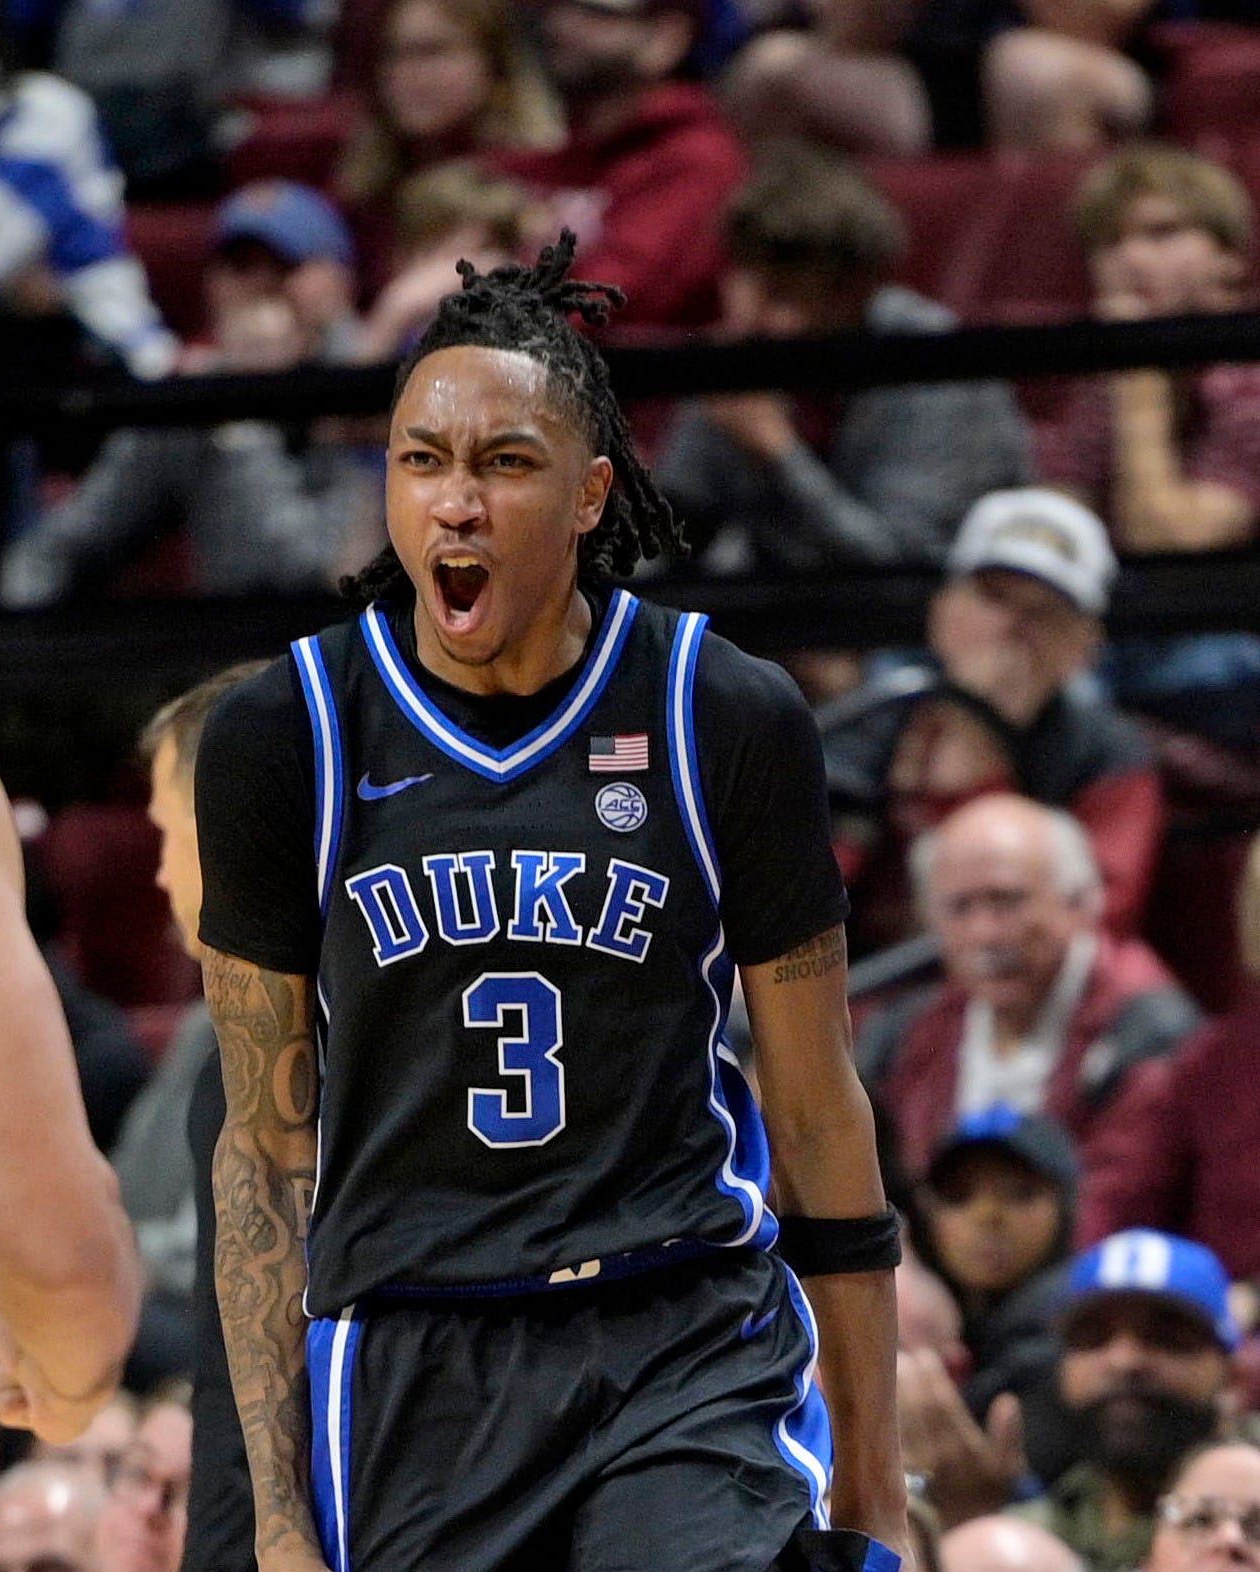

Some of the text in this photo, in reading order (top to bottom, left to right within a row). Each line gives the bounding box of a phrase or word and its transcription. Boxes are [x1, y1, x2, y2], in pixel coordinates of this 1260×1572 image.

[605, 799, 642, 813] ACC
[345, 850, 670, 968] DUKE
[462, 971, 565, 1149] 3
